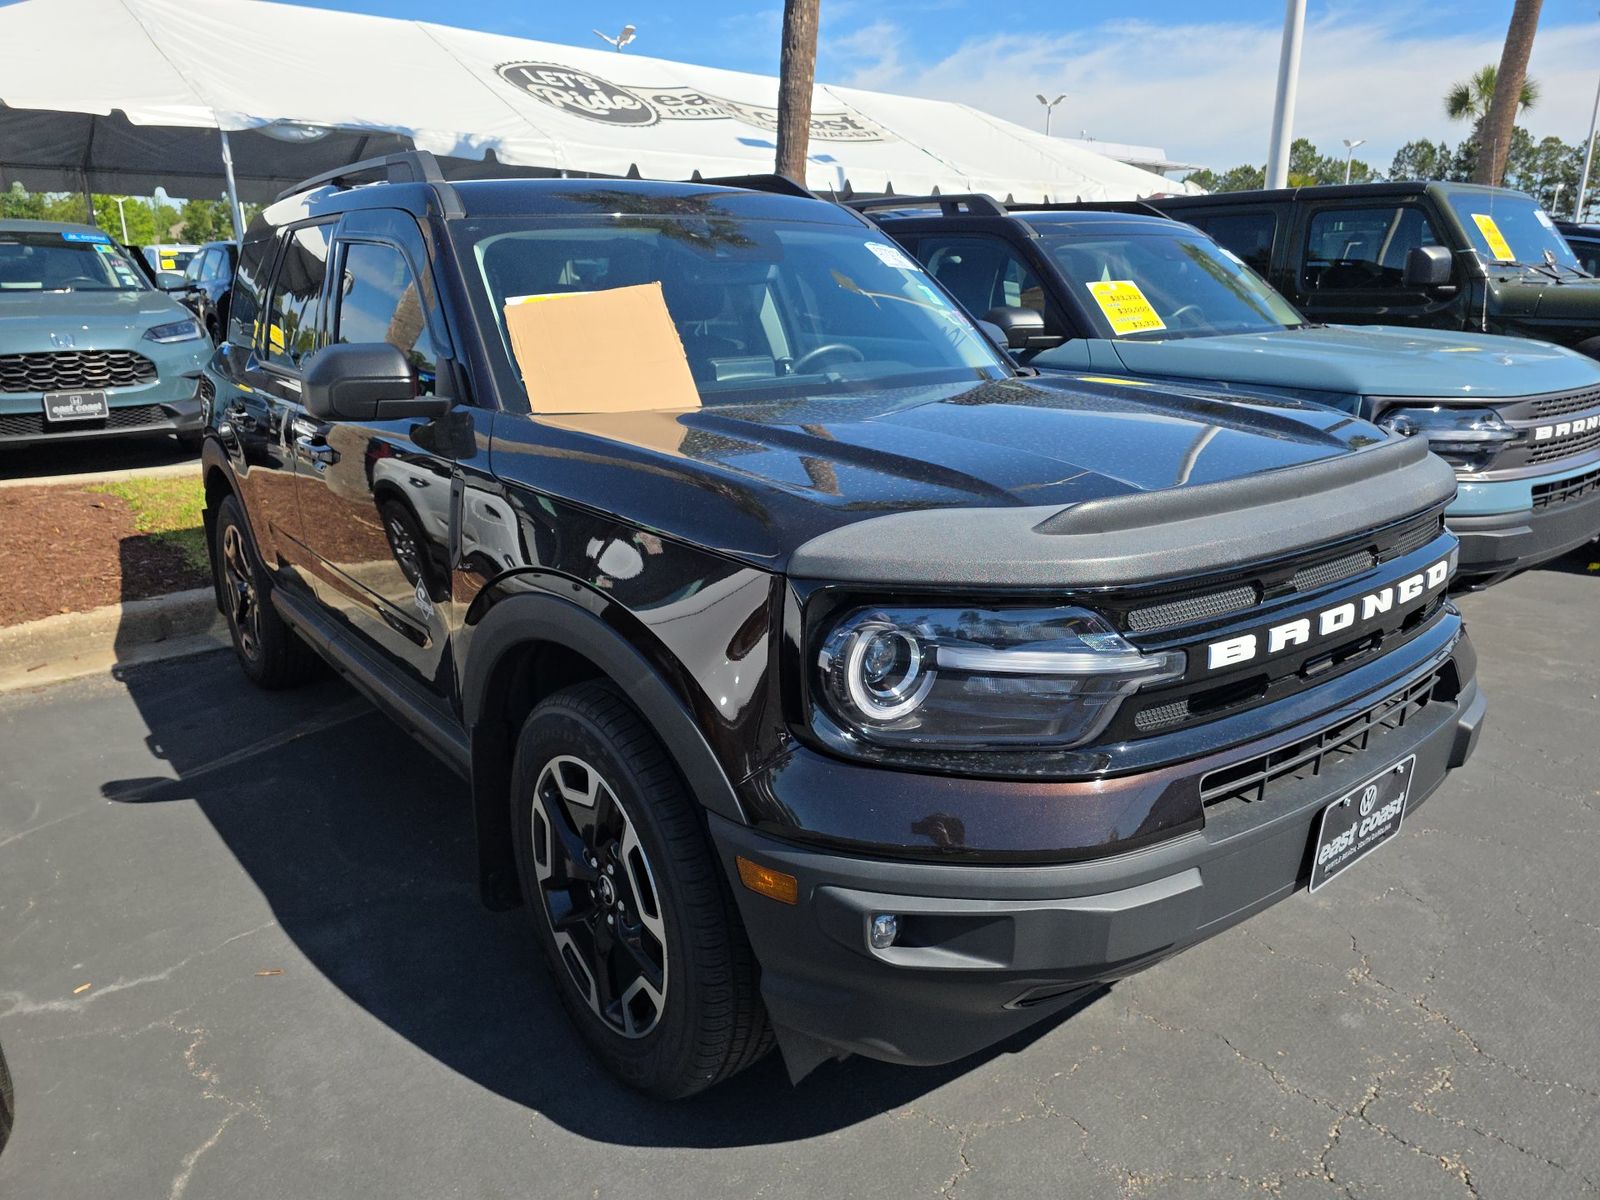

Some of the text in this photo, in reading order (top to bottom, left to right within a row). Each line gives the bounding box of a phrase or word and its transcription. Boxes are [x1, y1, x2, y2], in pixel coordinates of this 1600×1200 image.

[520, 68, 600, 91] LET'S
[527, 83, 642, 115] Ride
[753, 111, 865, 130] cast
[1535, 414, 1600, 441] BRON
[1207, 560, 1448, 670] BRONCO
[1317, 791, 1405, 866] east coast
